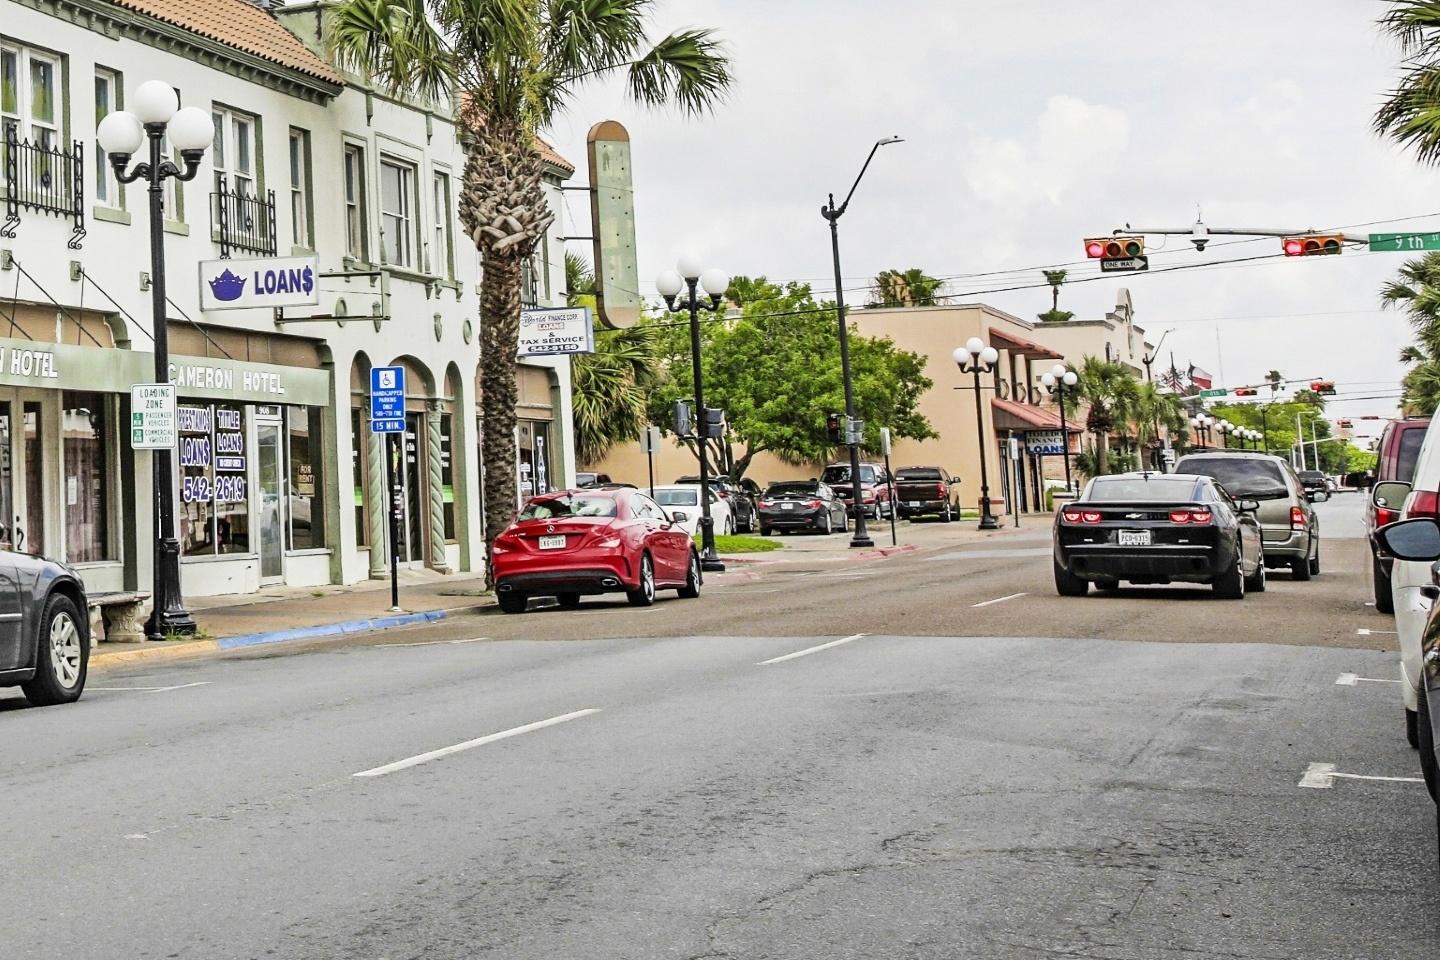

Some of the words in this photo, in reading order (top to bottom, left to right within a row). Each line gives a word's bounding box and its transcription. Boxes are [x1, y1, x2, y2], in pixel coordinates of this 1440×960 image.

[254, 265, 314, 296] LOAN$
[542, 336, 585, 344] SERVICE
[10, 349, 58, 378] HOTEL
[168, 363, 233, 389] CAMERON
[243, 371, 285, 394] HOTEL
[140, 388, 170, 398] LOADING
[145, 400, 163, 408] ZONE
[217, 410, 240, 429] TITLE
[376, 422, 383, 430] 15
[216, 476, 245, 501] 2619
